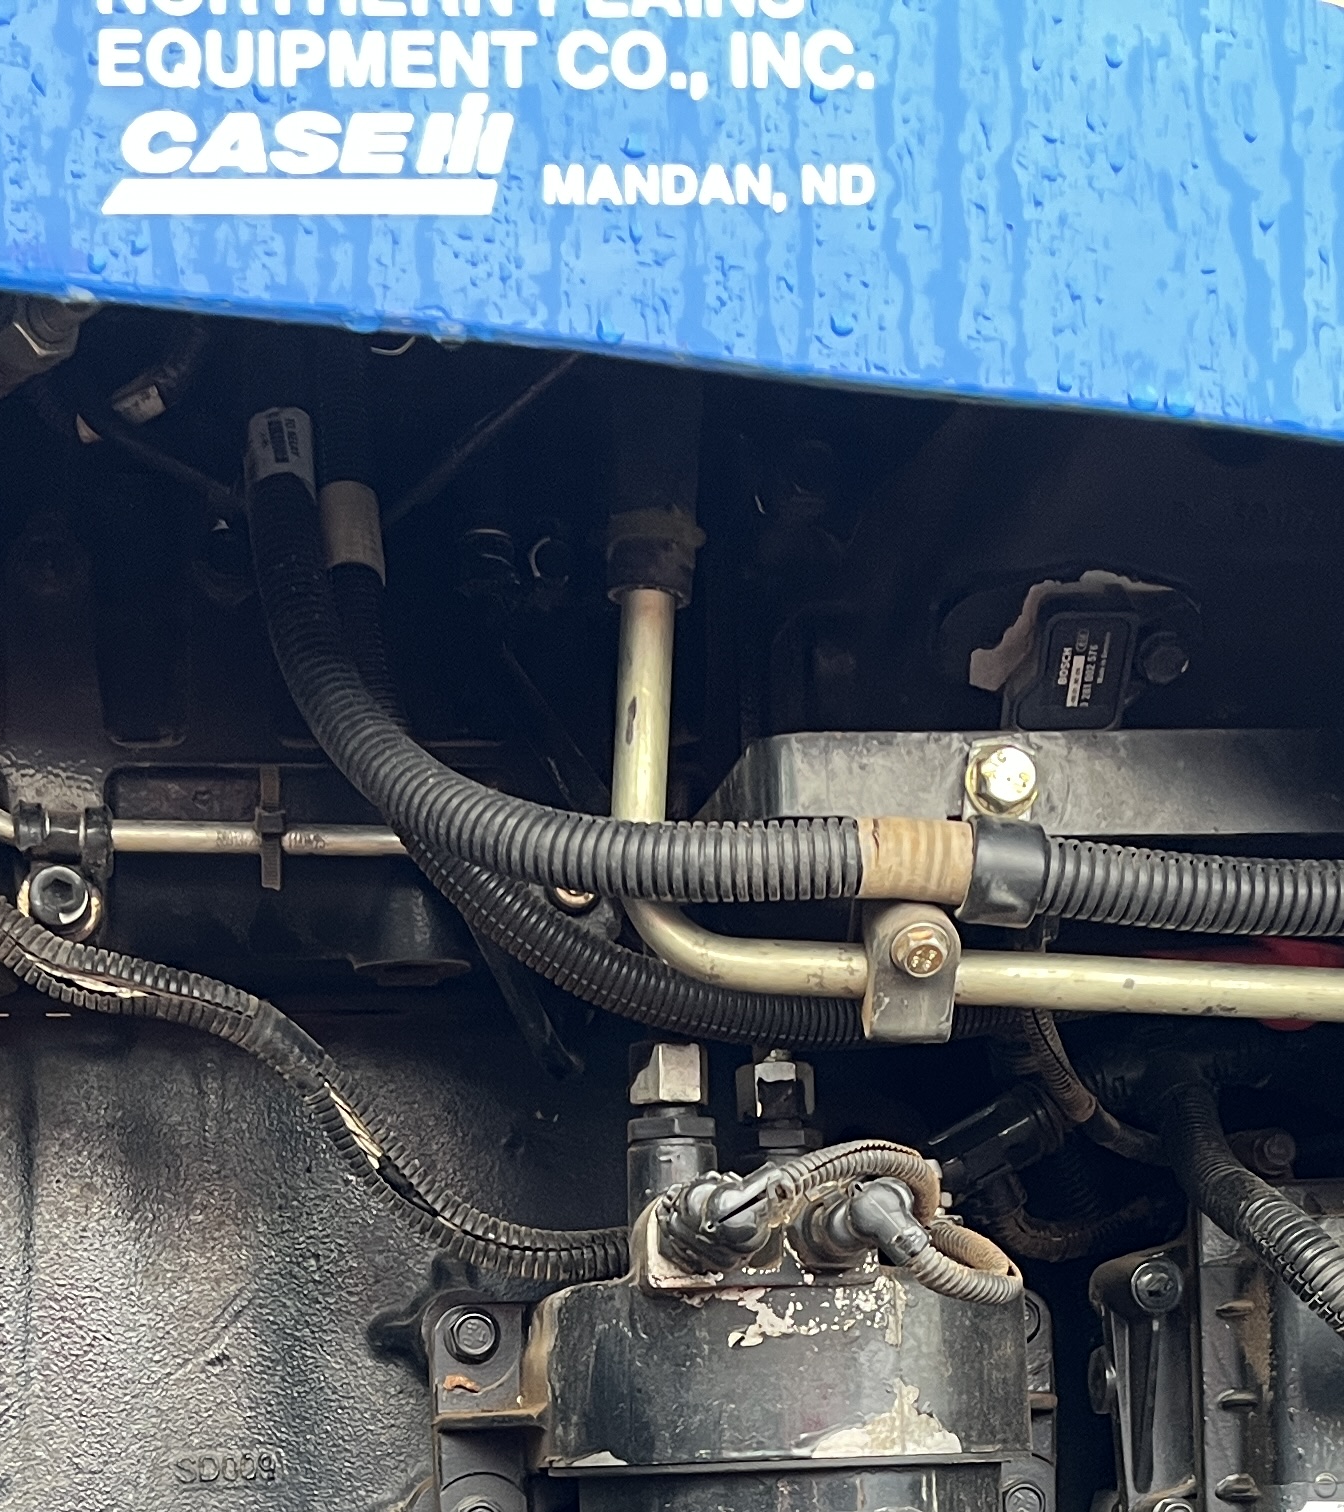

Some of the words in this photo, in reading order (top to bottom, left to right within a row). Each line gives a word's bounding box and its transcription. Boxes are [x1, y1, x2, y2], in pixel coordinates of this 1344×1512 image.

[97, 28, 538, 90] EQUIPMENT
[557, 29, 709, 101] CO.,
[730, 29, 875, 90] INC.
[543, 163, 787, 213] MANDAN,
[801, 163, 876, 206] ND
[1057, 647, 1073, 685] BOSCH
